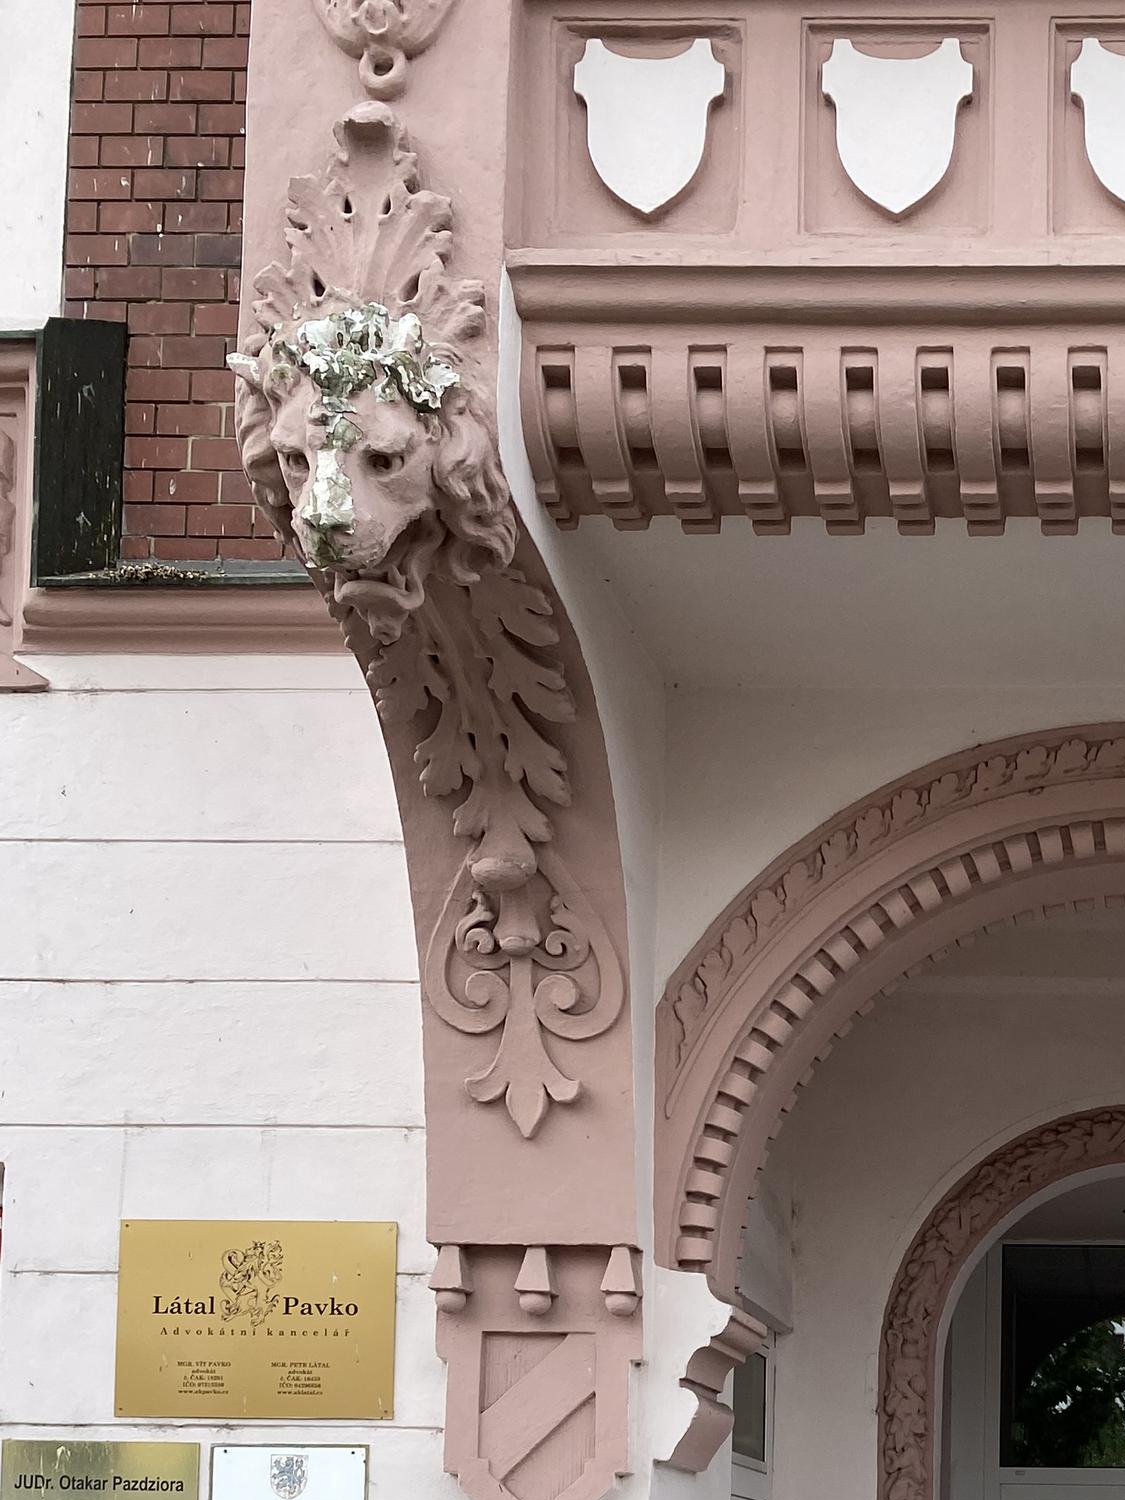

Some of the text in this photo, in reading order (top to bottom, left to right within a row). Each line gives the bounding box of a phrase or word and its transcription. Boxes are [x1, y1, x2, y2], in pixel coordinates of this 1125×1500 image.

[152, 1295, 359, 1316] Látal Pavko
[160, 1327, 351, 1337] Advokátní kancelář
[14, 1474, 184, 1492] JUDr. Otakar Pazdziora
